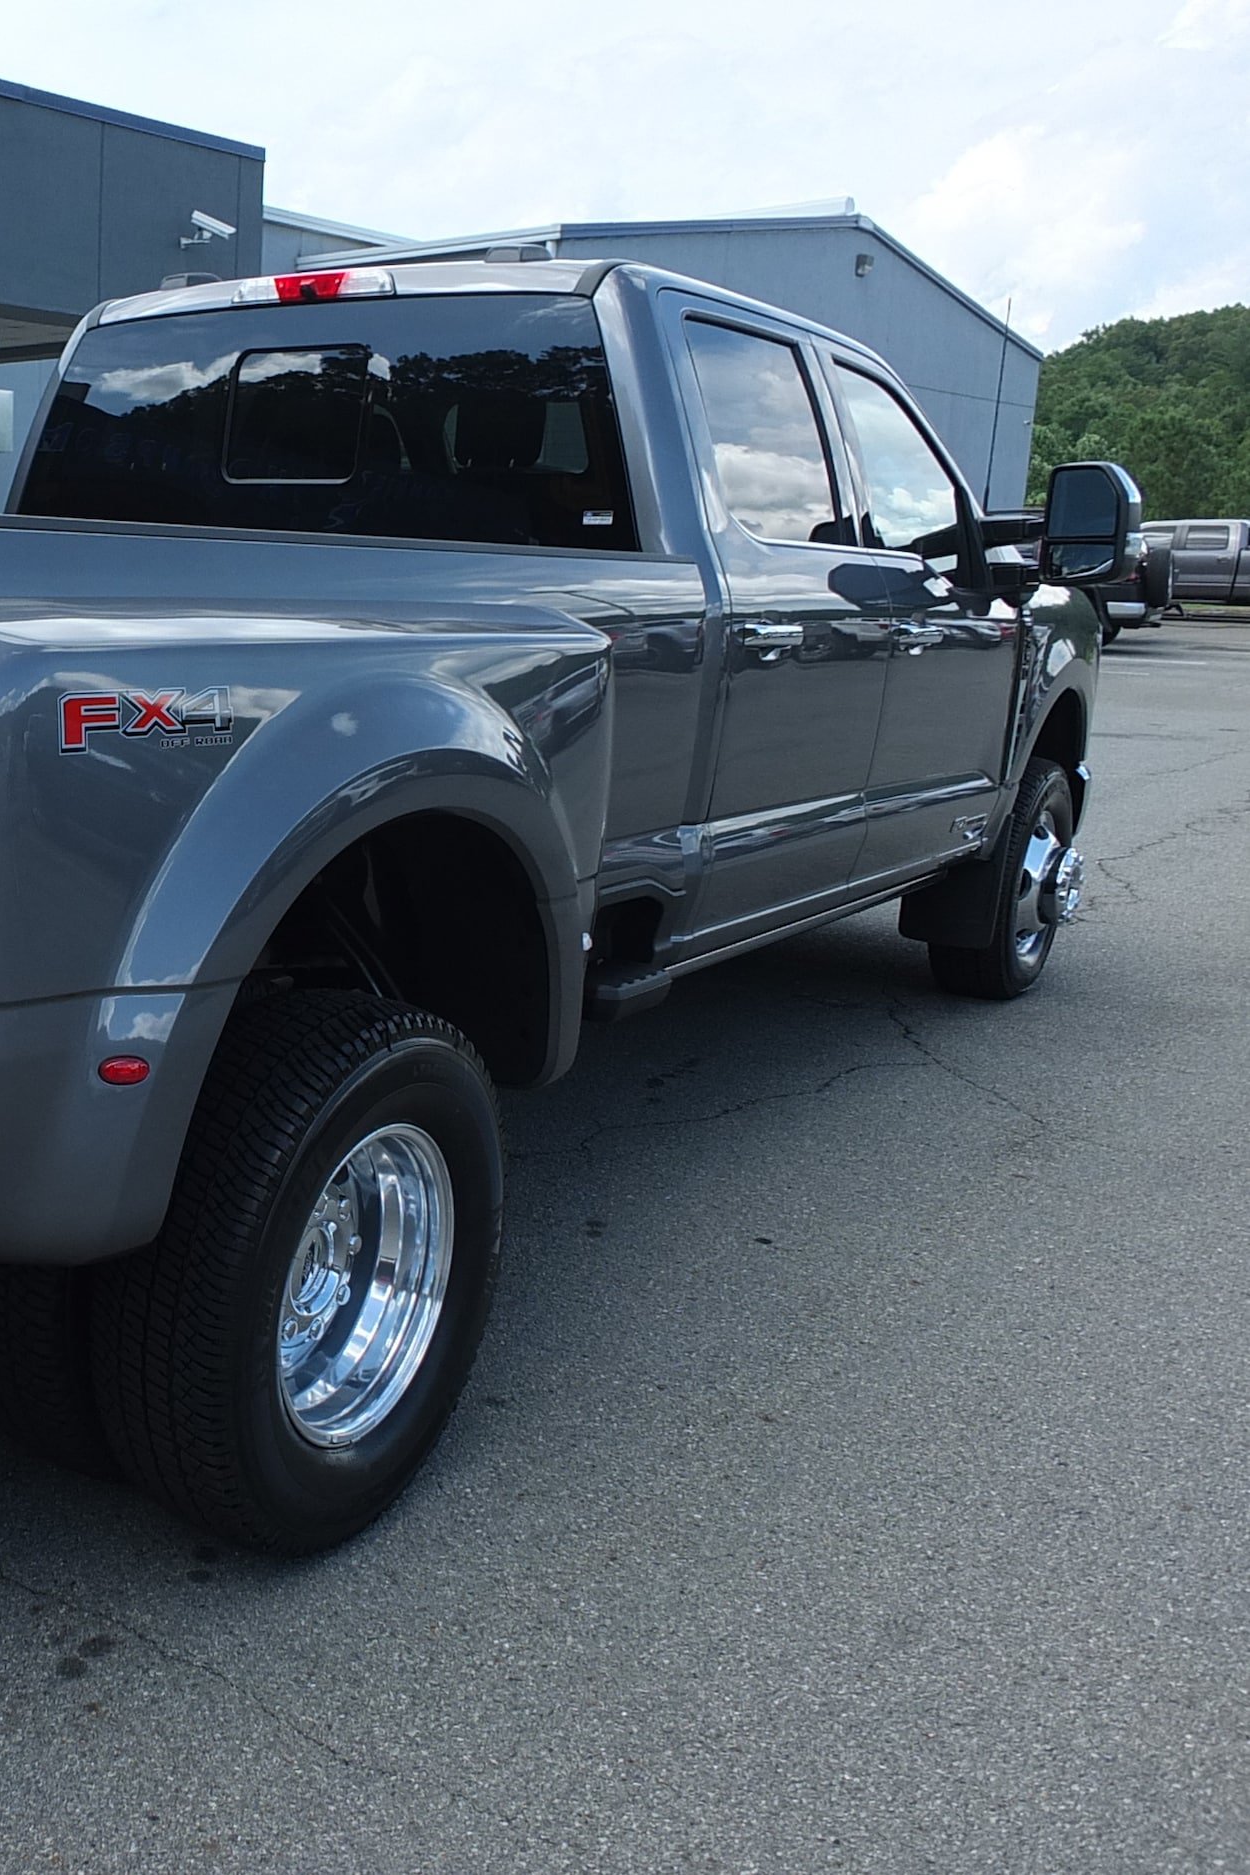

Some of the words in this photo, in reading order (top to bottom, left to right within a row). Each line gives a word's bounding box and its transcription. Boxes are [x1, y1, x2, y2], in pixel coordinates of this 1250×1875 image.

[58, 686, 233, 756] FX4
[160, 737, 190, 750] OFF
[194, 735, 233, 746] ROAD
